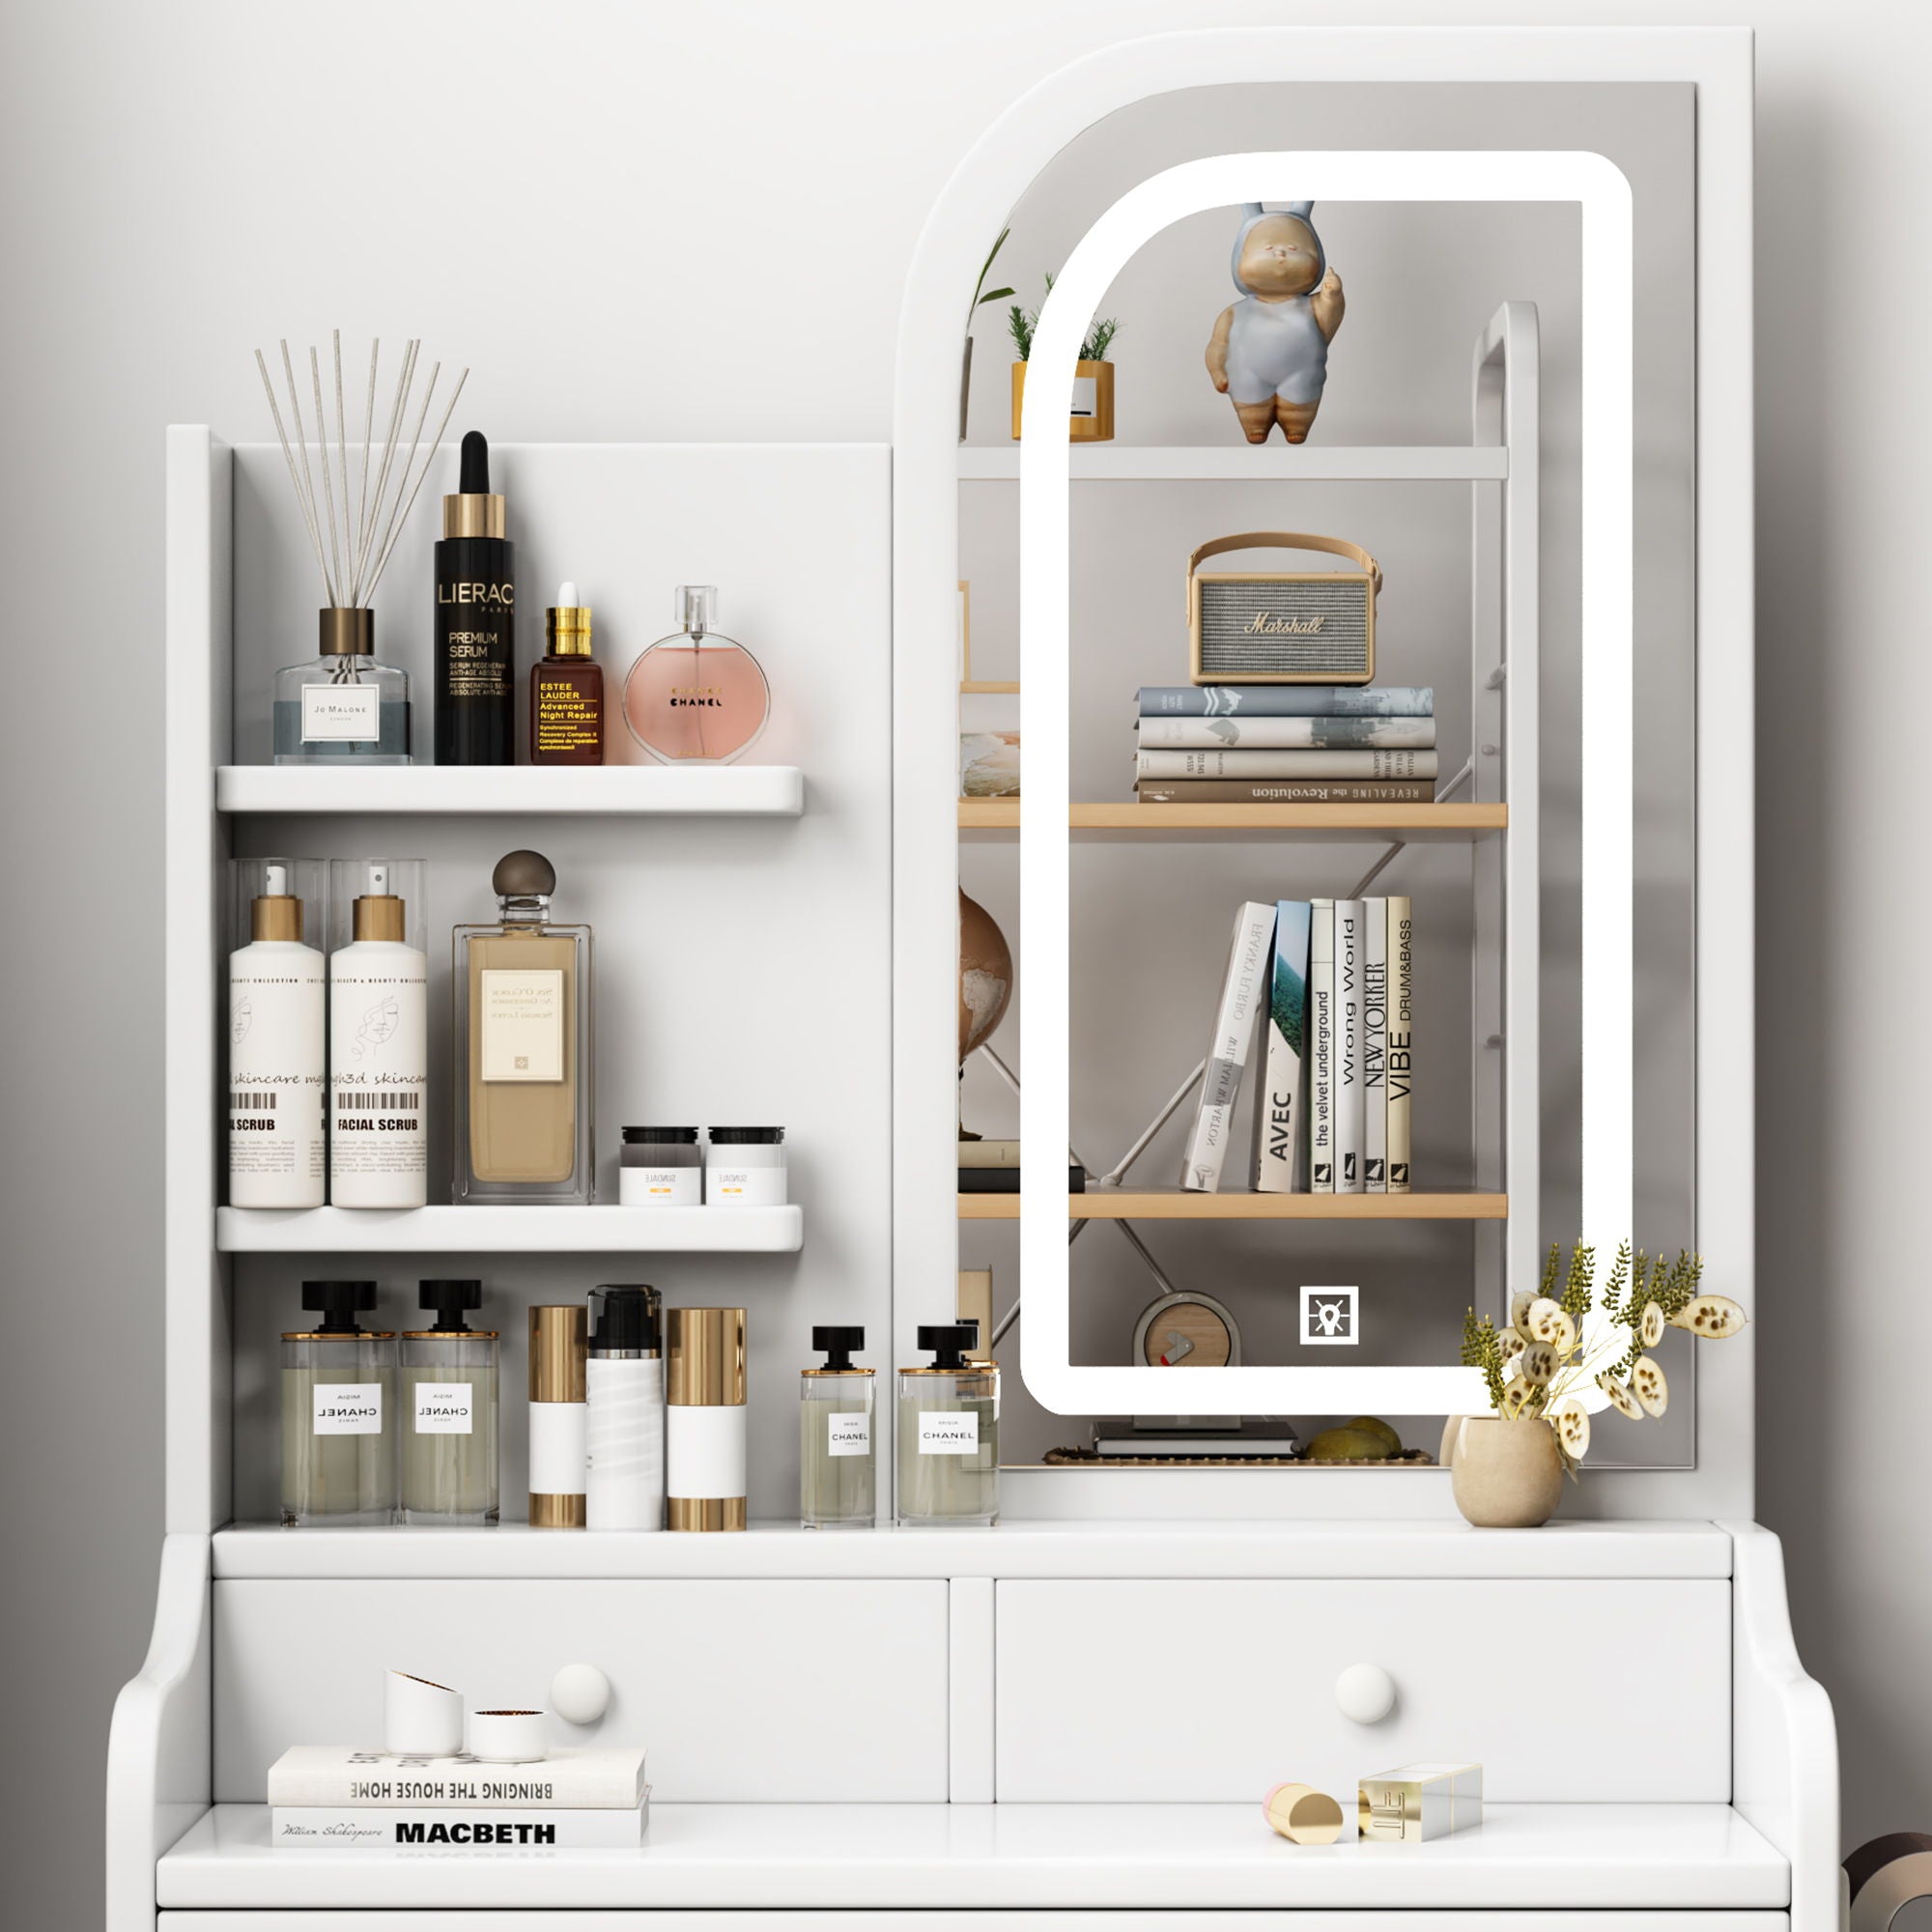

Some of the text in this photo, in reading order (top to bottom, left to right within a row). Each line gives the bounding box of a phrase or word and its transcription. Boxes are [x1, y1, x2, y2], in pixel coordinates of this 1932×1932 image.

[439, 582, 514, 605] LIERAC
[1244, 611, 1325, 634] Marshall
[449, 632, 497, 645] PREMIUM
[449, 645, 488, 658] SERUM
[669, 697, 723, 707] CHANEL
[540, 711, 598, 721] Night Repair
[1252, 787, 1420, 800] REVEALING the Revolution
[1344, 920, 1356, 1085] Wrong World
[1389, 920, 1410, 1101] VIBE DRUM&BASS
[1316, 992, 1330, 1147] the velvet underground
[234, 1072, 300, 1085] skincare
[236, 1119, 275, 1131] SCRUB
[337, 1119, 375, 1130] FACIAL
[378, 1119, 418, 1131] SCRUB
[1269, 1093, 1292, 1161] AVEC
[351, 1782, 553, 1800] BRINGING THE HOUSE HOME
[282, 1824, 318, 1835] William
[395, 1823, 555, 1844] MACBETH
